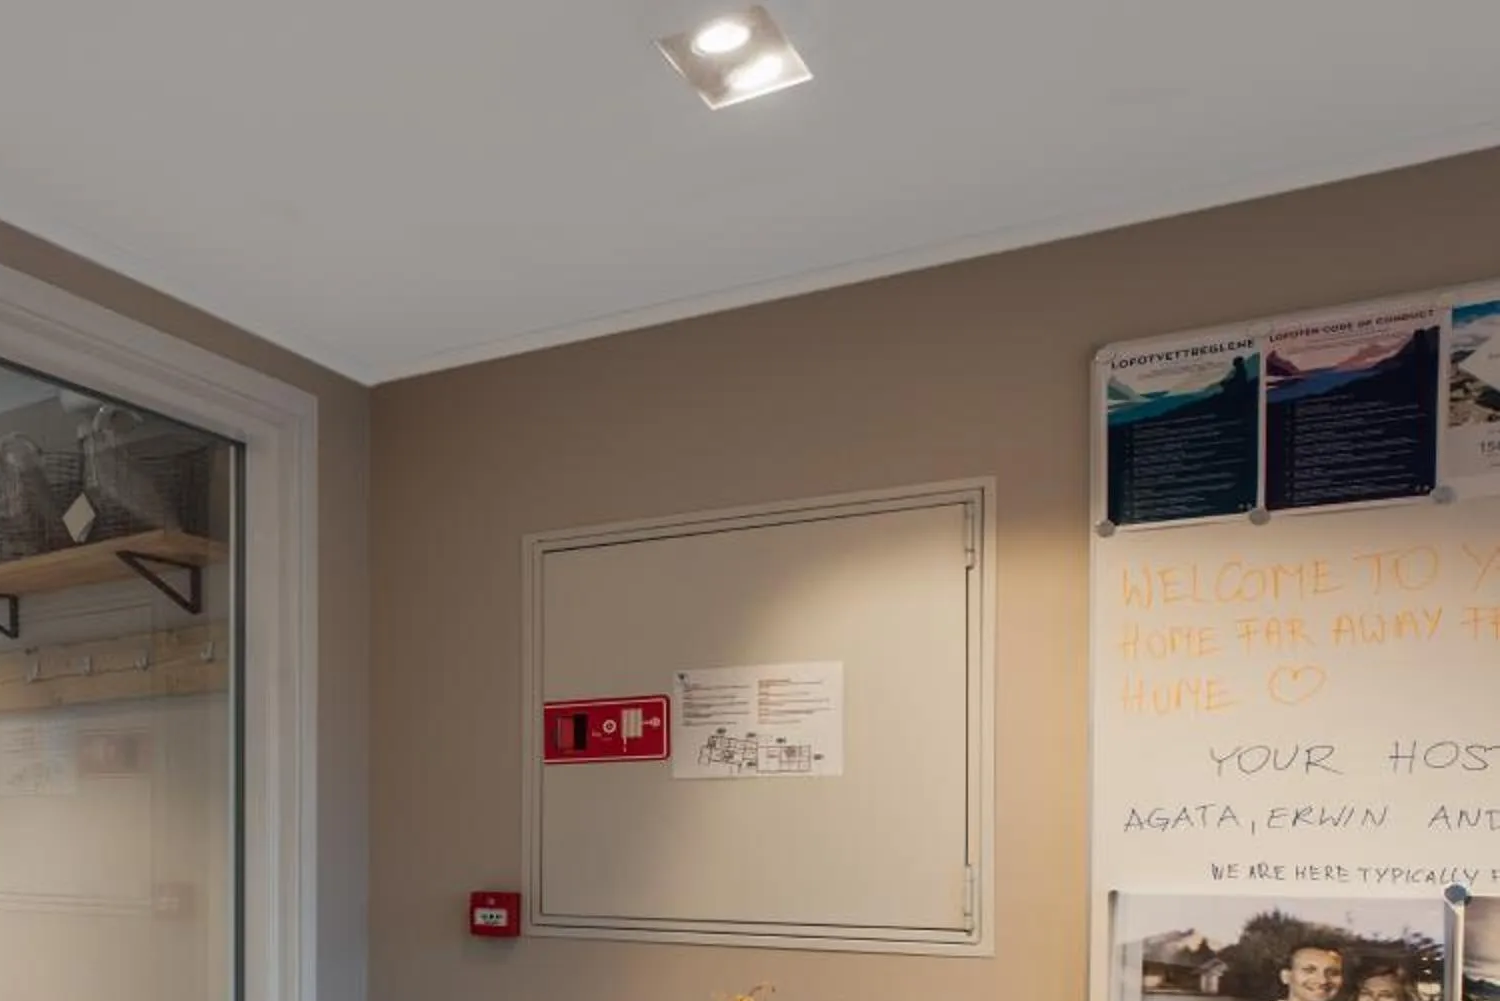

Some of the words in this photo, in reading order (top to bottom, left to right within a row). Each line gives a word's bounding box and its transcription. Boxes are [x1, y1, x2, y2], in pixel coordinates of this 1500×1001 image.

[1122, 557, 1343, 609] WELCOME
[1354, 545, 1439, 595] TO
[1120, 621, 1220, 658] HOME
[1235, 614, 1315, 654] FAR
[1332, 606, 1443, 646] AWAY
[1209, 744, 1343, 777] YOUR
[1266, 804, 1389, 833] ERWIN
[1211, 862, 1240, 881] WE
[1249, 862, 1286, 881] ARE
[1295, 865, 1350, 883] HERE
[1357, 866, 1479, 885] TYPICALLY
